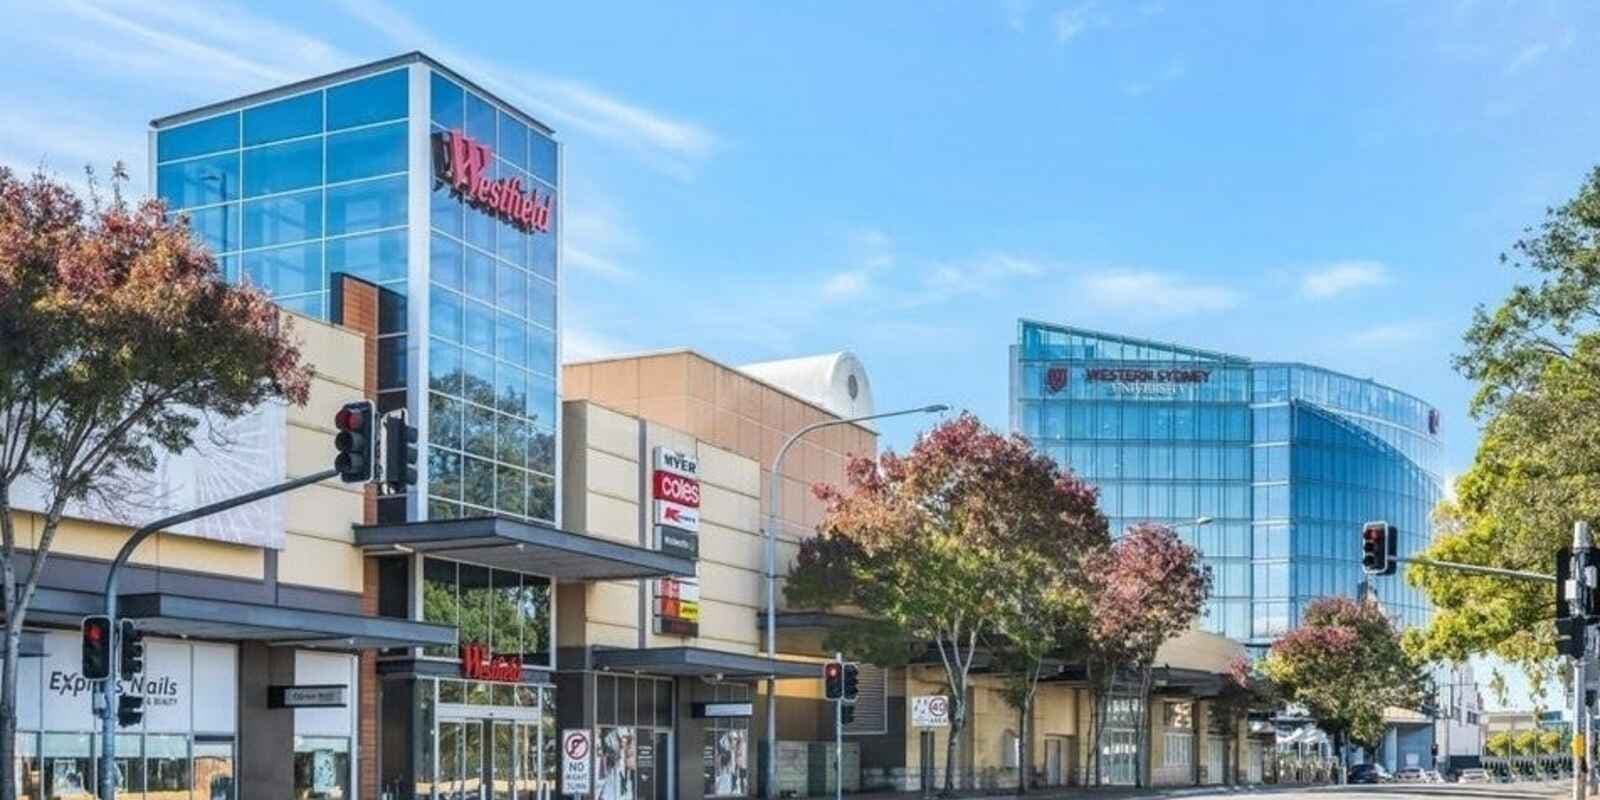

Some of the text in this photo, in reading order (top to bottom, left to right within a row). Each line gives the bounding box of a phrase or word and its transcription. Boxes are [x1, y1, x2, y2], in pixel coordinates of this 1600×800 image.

[445, 128, 551, 232] Westfield
[1085, 368, 1211, 383] WESTERN SYDNEY
[664, 453, 697, 473] MYER
[662, 477, 699, 503] coles
[130, 676, 178, 696] Nails
[569, 762, 584, 771] NO
